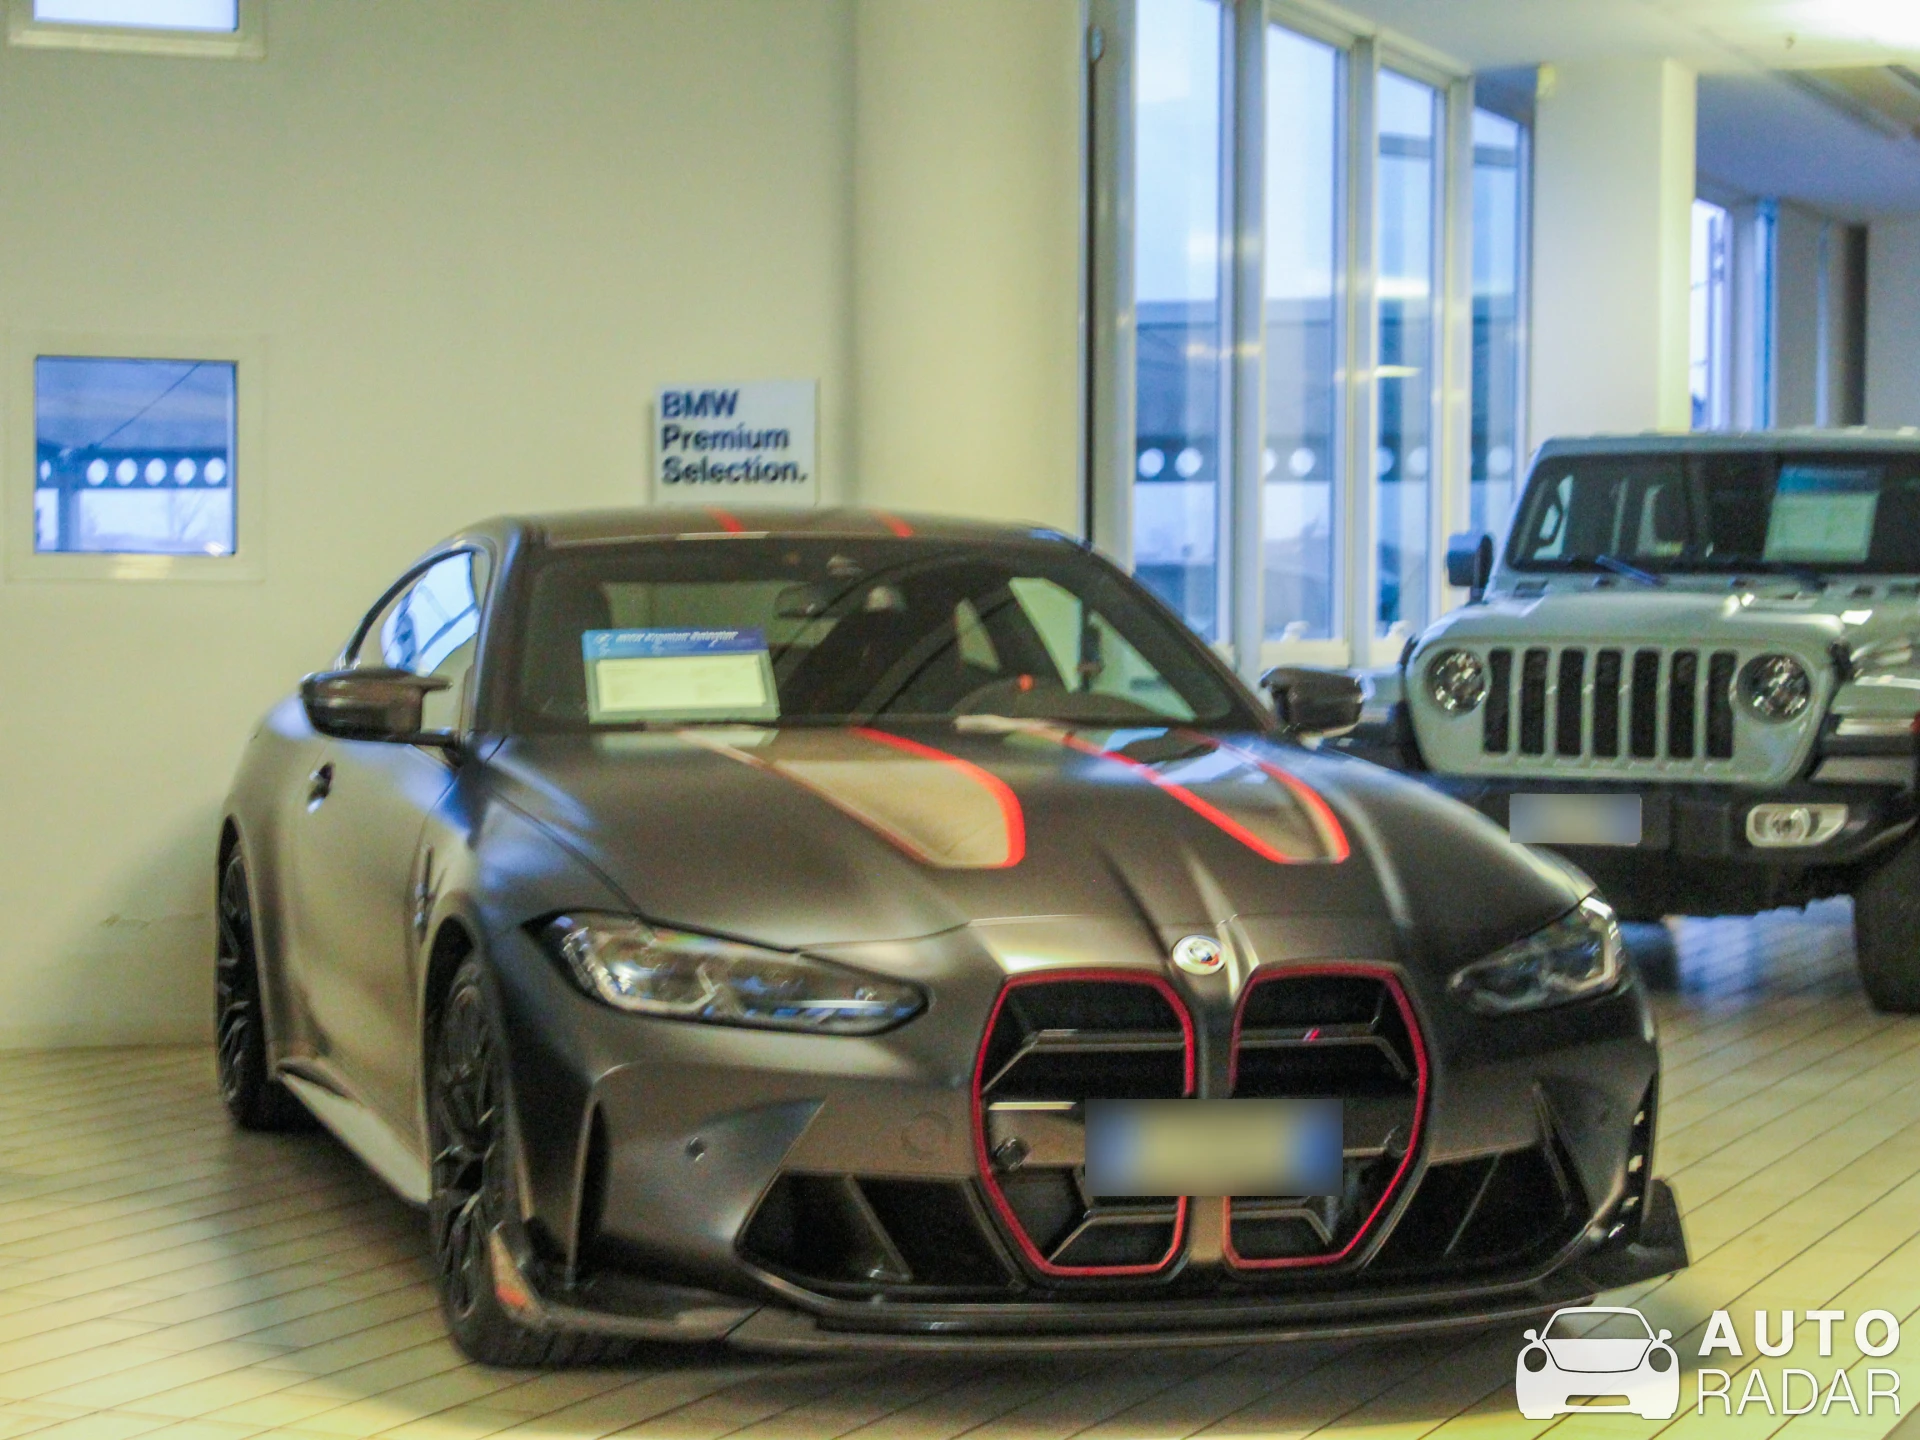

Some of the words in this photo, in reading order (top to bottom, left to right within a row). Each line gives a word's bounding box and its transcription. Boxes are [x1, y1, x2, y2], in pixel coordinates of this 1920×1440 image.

[661, 390, 739, 418] BMW
[661, 424, 789, 451] Premium
[662, 456, 807, 484] Selection.
